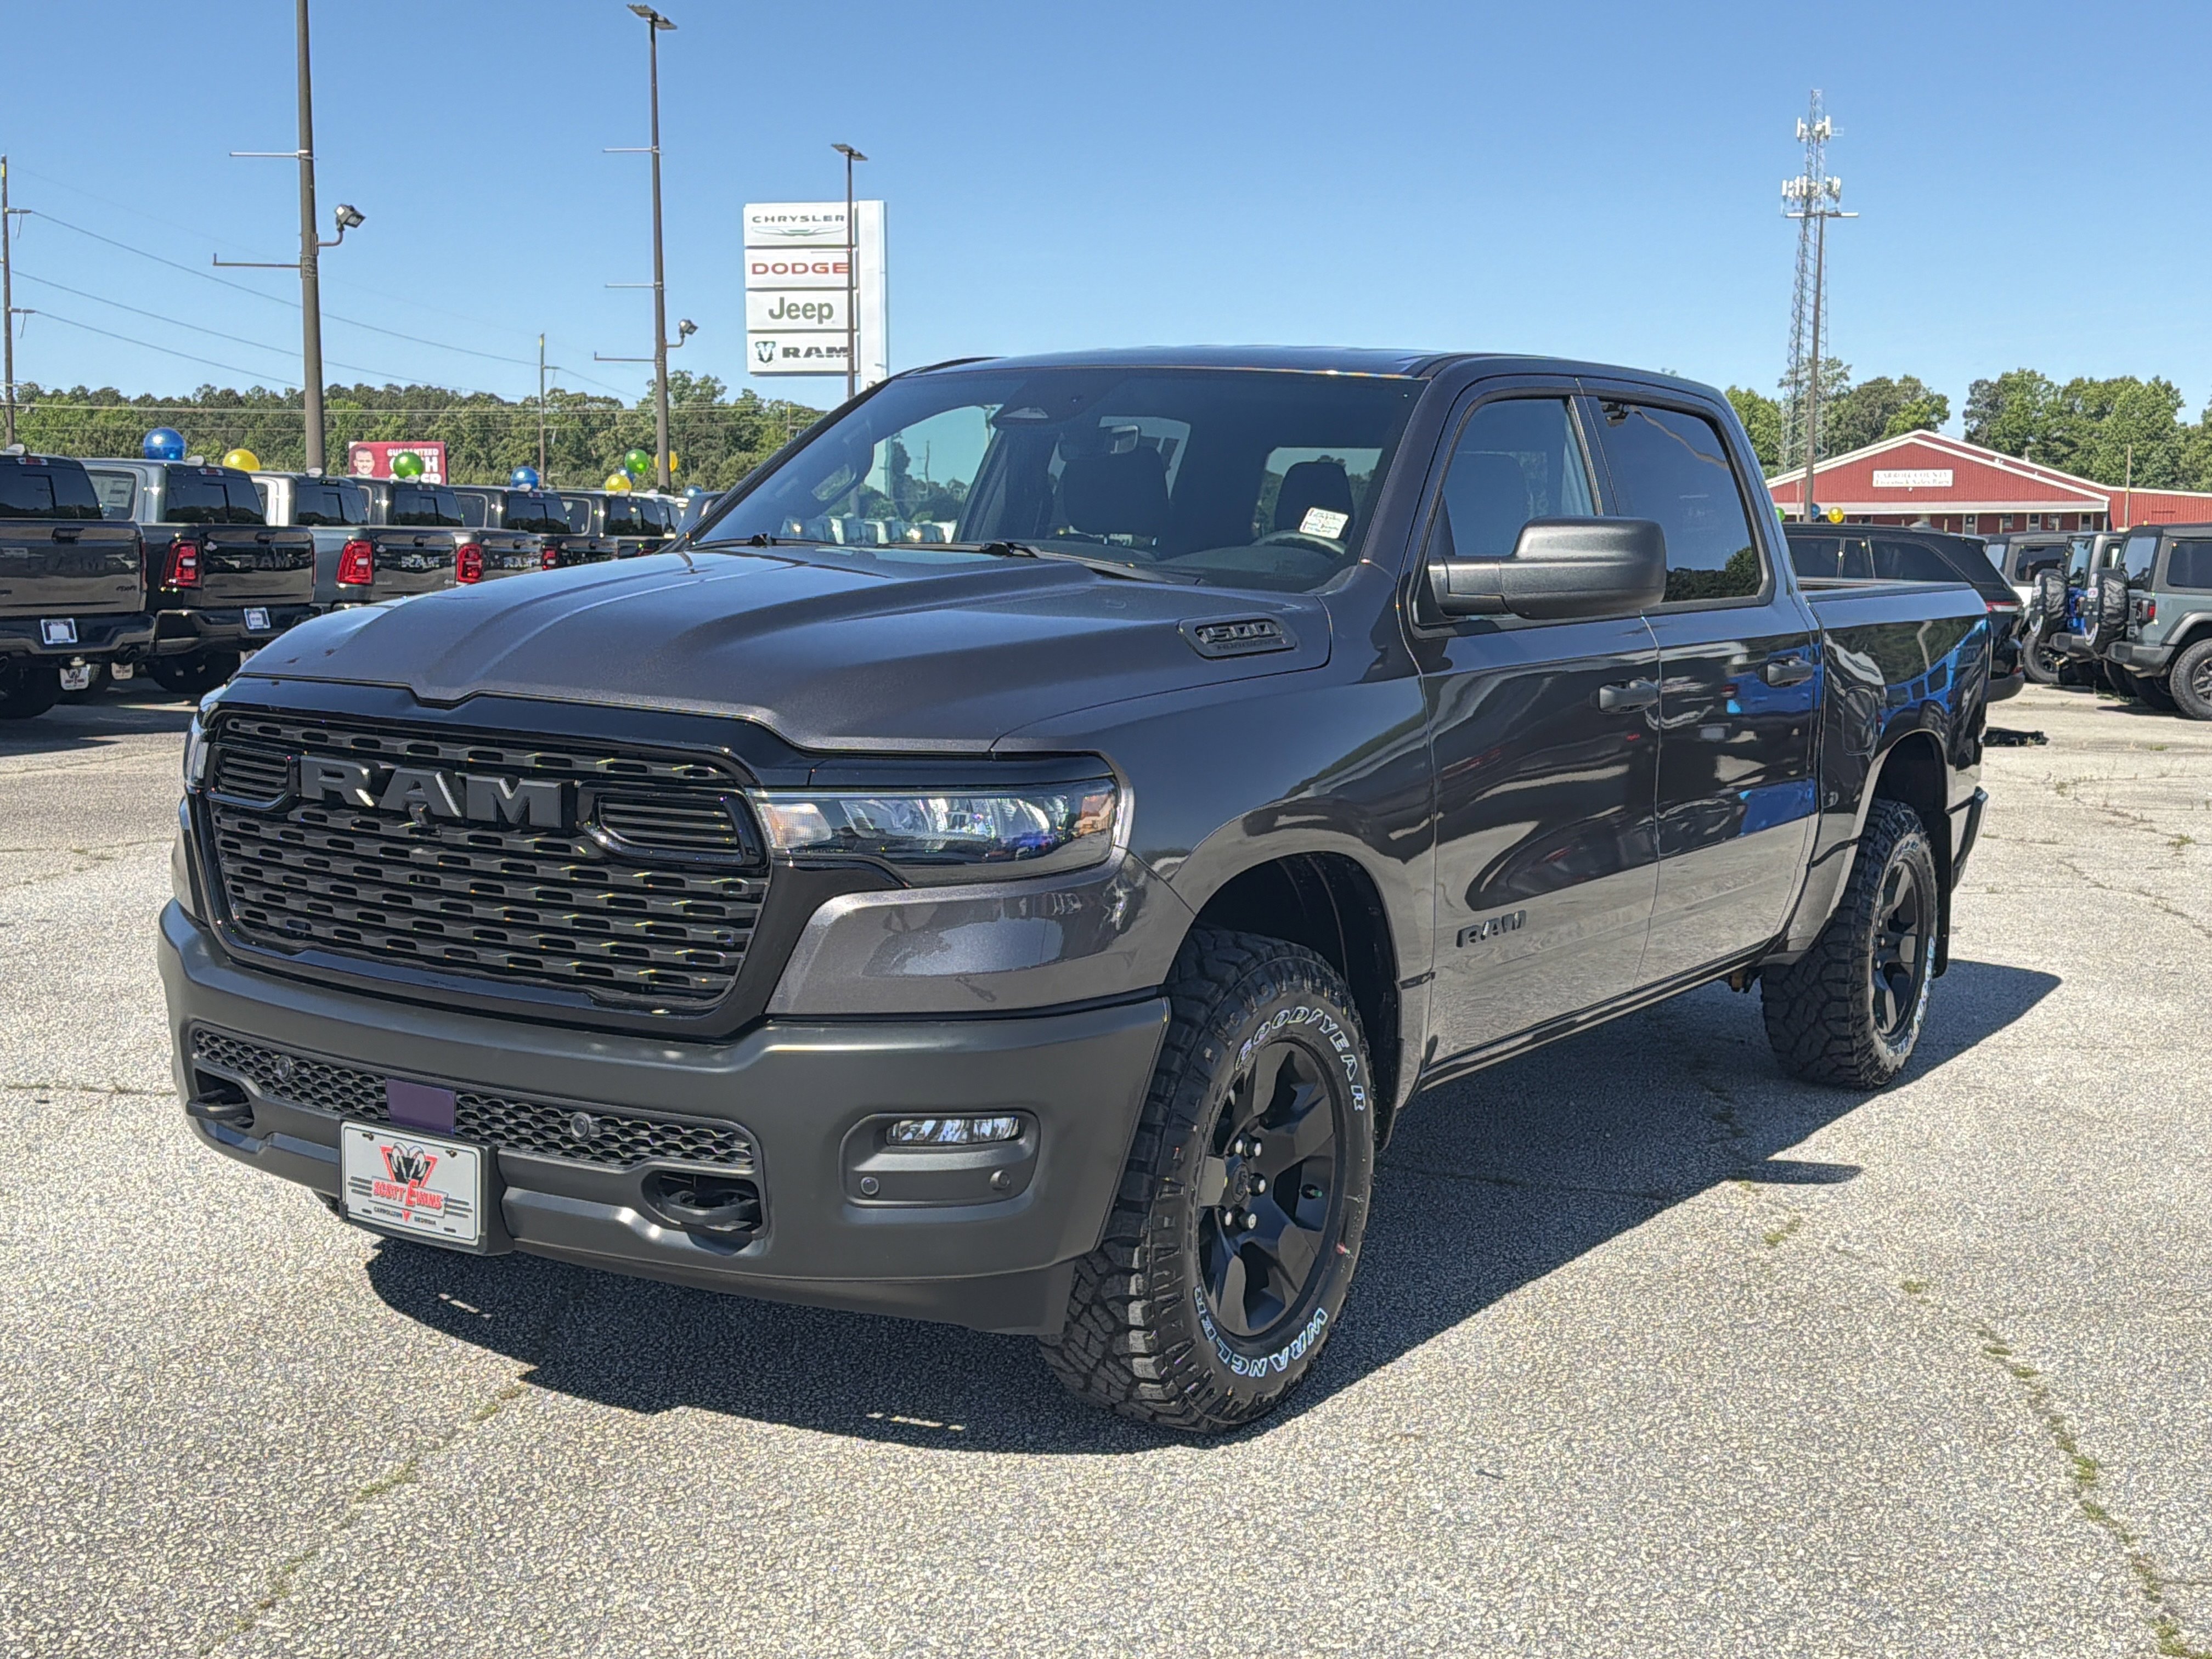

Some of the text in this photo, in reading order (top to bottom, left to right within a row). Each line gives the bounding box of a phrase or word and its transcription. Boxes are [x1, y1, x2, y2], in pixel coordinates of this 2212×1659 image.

[752, 215, 845, 223] CHRYSLER
[751, 262, 850, 275] DODGE
[768, 296, 834, 324] Jeep
[782, 346, 852, 358] RAM
[240, 556, 292, 568] RAM
[1196, 621, 1282, 645] 1500
[300, 755, 563, 828] RAM
[1455, 909, 1527, 948] RAM
[1235, 1006, 1366, 1111] GOODYEAR
[374, 1180, 405, 1202] SCOTT
[1194, 1285, 1329, 1378] WRANGLER
